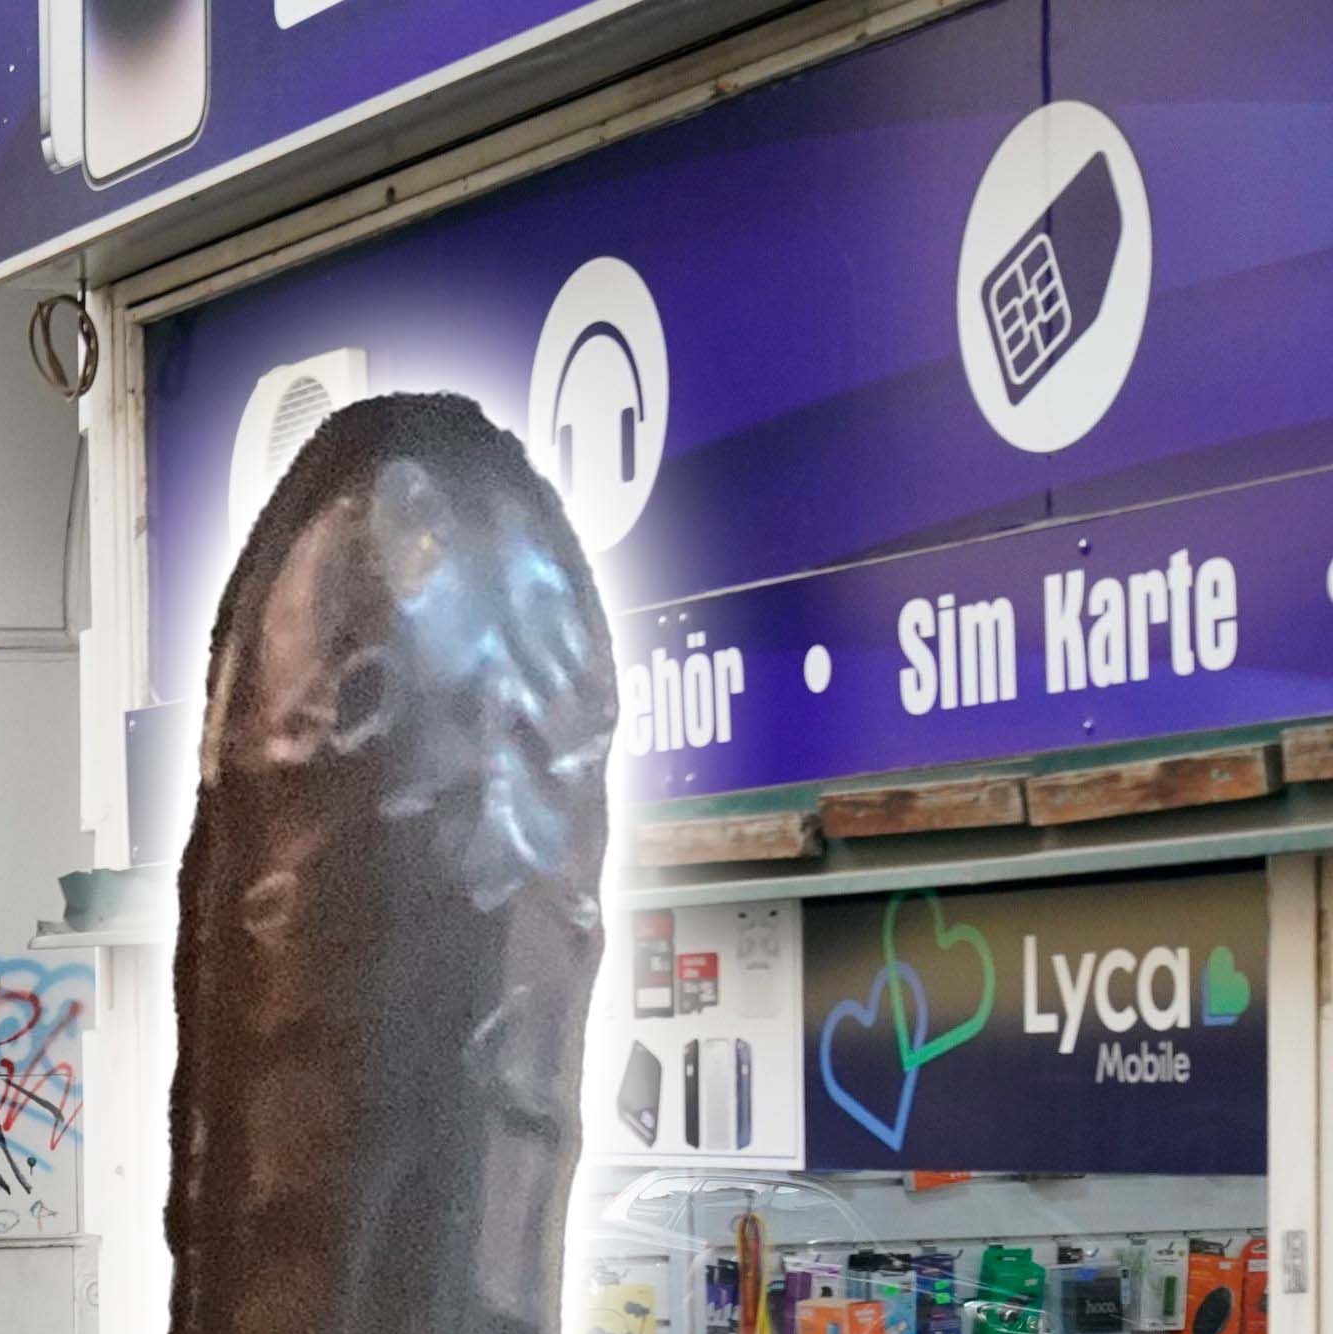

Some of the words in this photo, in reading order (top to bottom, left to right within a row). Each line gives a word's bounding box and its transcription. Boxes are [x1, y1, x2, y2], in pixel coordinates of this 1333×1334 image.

[898, 592, 1018, 716] Sim
[1045, 548, 1238, 694] Karte
[1022, 934, 1191, 1054] Lyca
[1095, 1042, 1191, 1084] Mobile
